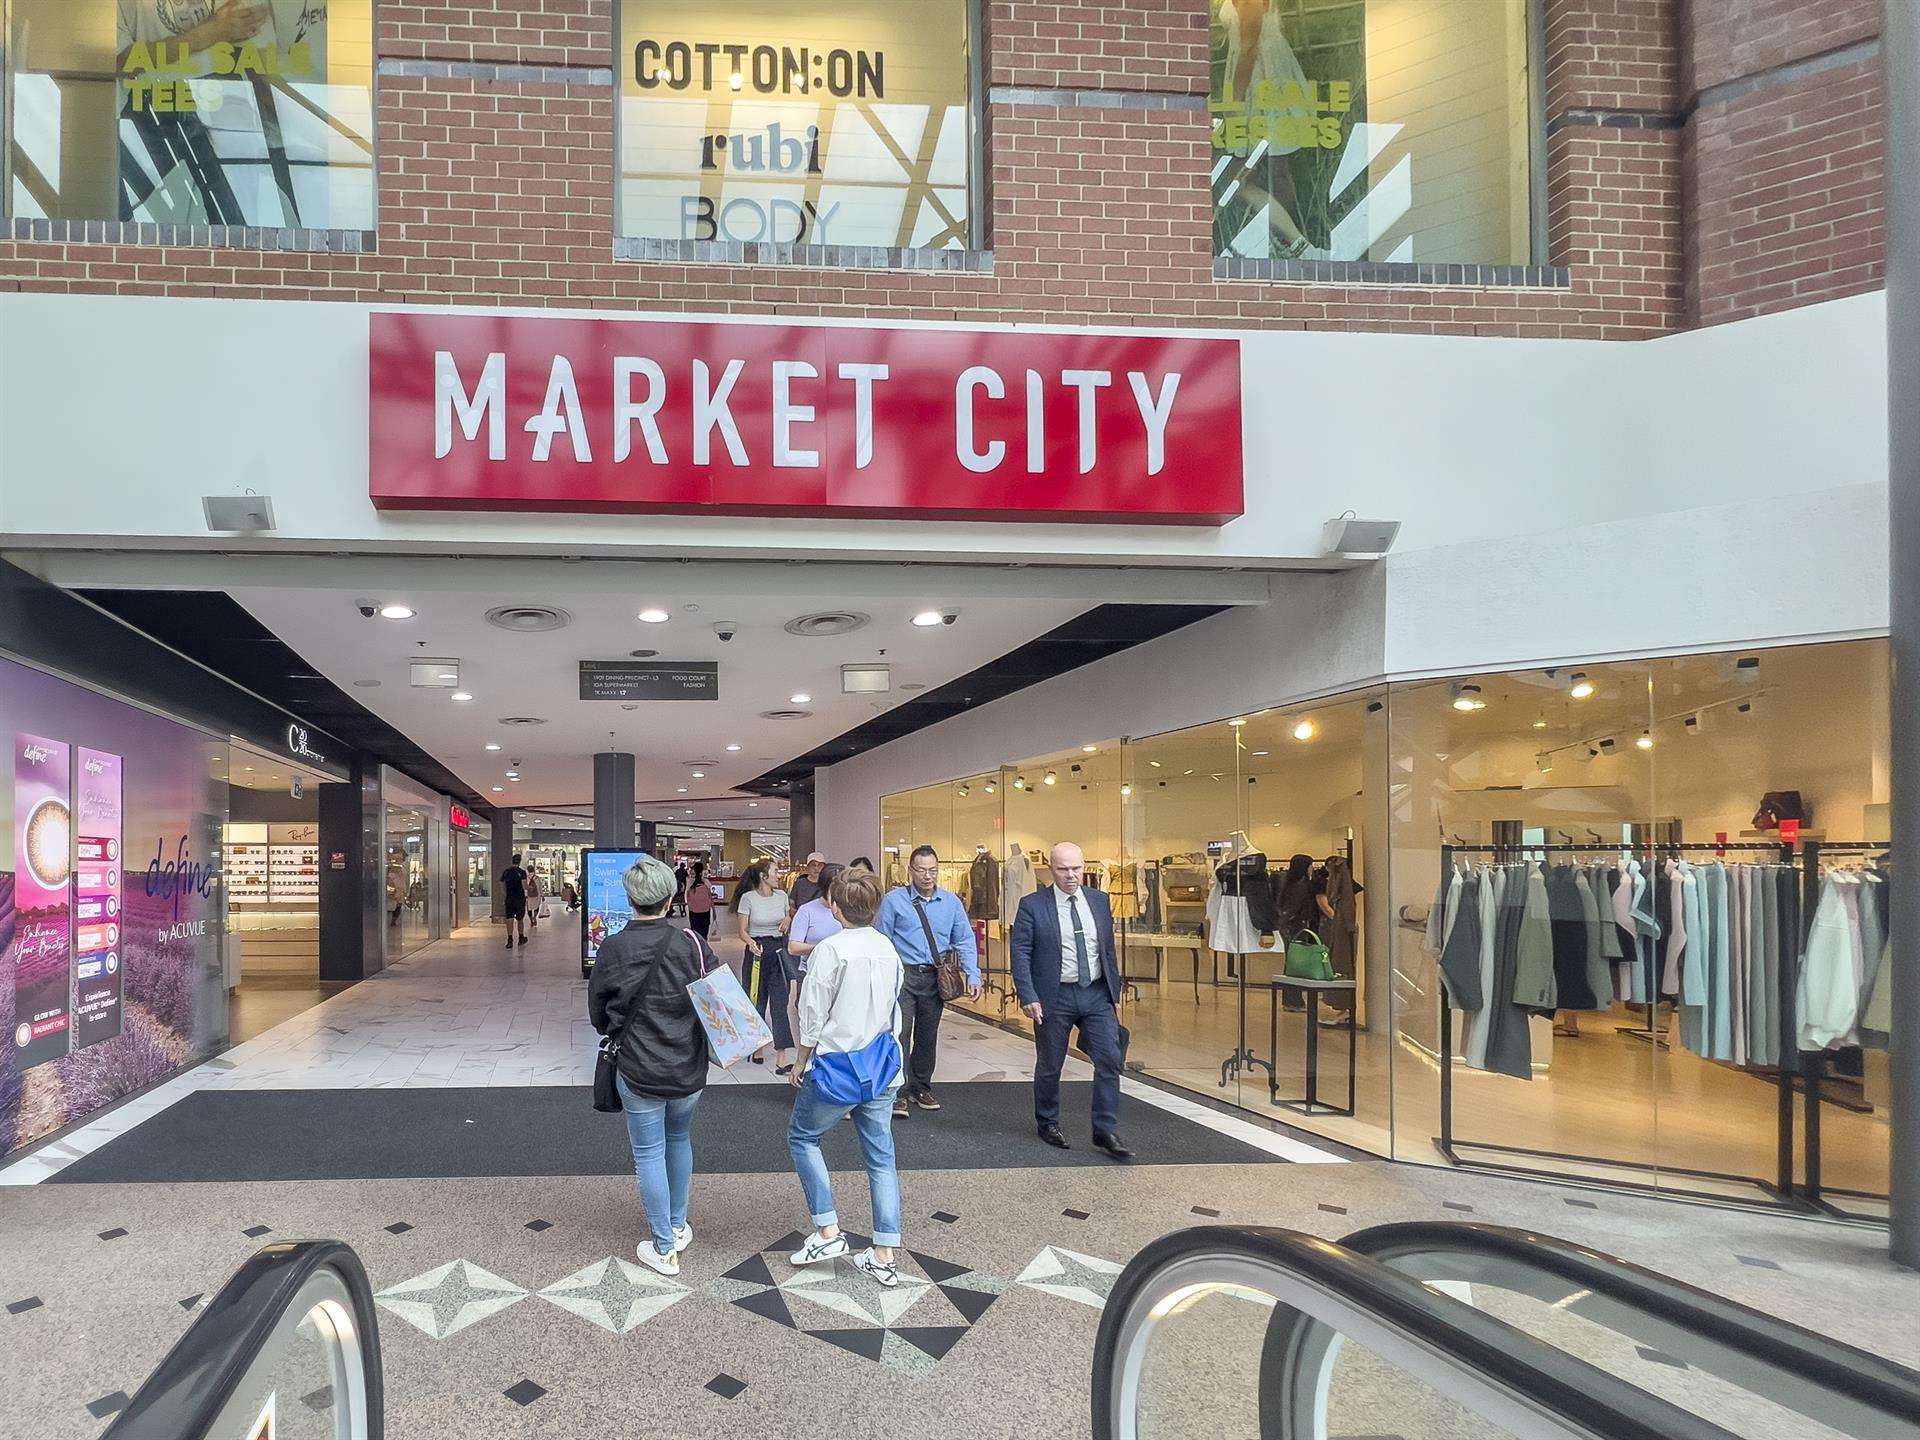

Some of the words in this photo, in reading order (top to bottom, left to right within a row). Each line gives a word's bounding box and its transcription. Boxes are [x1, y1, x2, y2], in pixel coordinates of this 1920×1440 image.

[123, 40, 197, 73] ALL
[212, 41, 311, 75] SALE
[635, 39, 884, 99] COTTON:ON
[124, 78, 224, 112] TEES
[1257, 79, 1350, 112] SALE
[699, 122, 822, 174] rubi
[1211, 115, 1342, 149] RESSES
[681, 196, 840, 244] BODY
[434, 351, 888, 469] MARKET
[955, 366, 1181, 475] CITY
[146, 834, 212, 921] define
[159, 927, 169, 944] by
[170, 920, 206, 940] ACUVUE
[85, 989, 111, 1002] Experience
